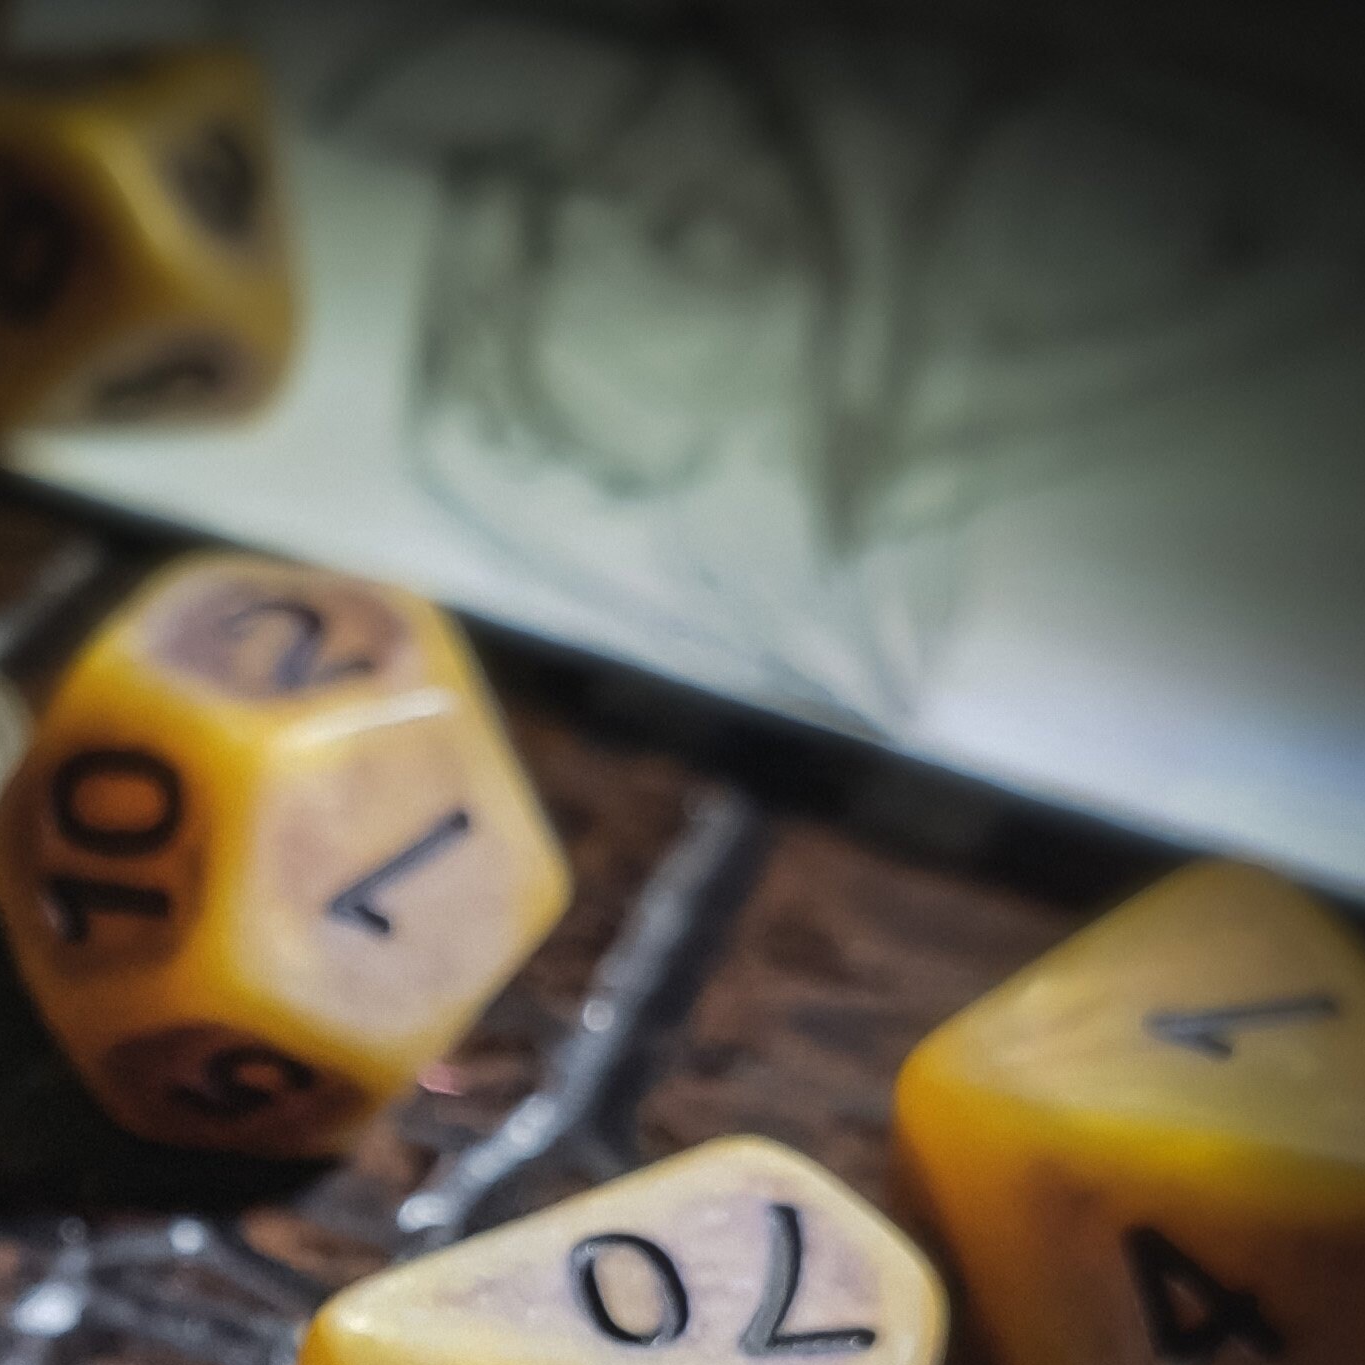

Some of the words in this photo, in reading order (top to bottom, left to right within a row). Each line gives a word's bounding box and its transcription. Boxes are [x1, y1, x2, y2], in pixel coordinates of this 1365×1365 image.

[218, 598, 376, 693] 2
[42, 743, 187, 944] 10
[327, 807, 472, 936] 1
[1142, 995, 1342, 1061] 1
[569, 1203, 878, 1359] 70
[1121, 1223, 1288, 1365] 4
